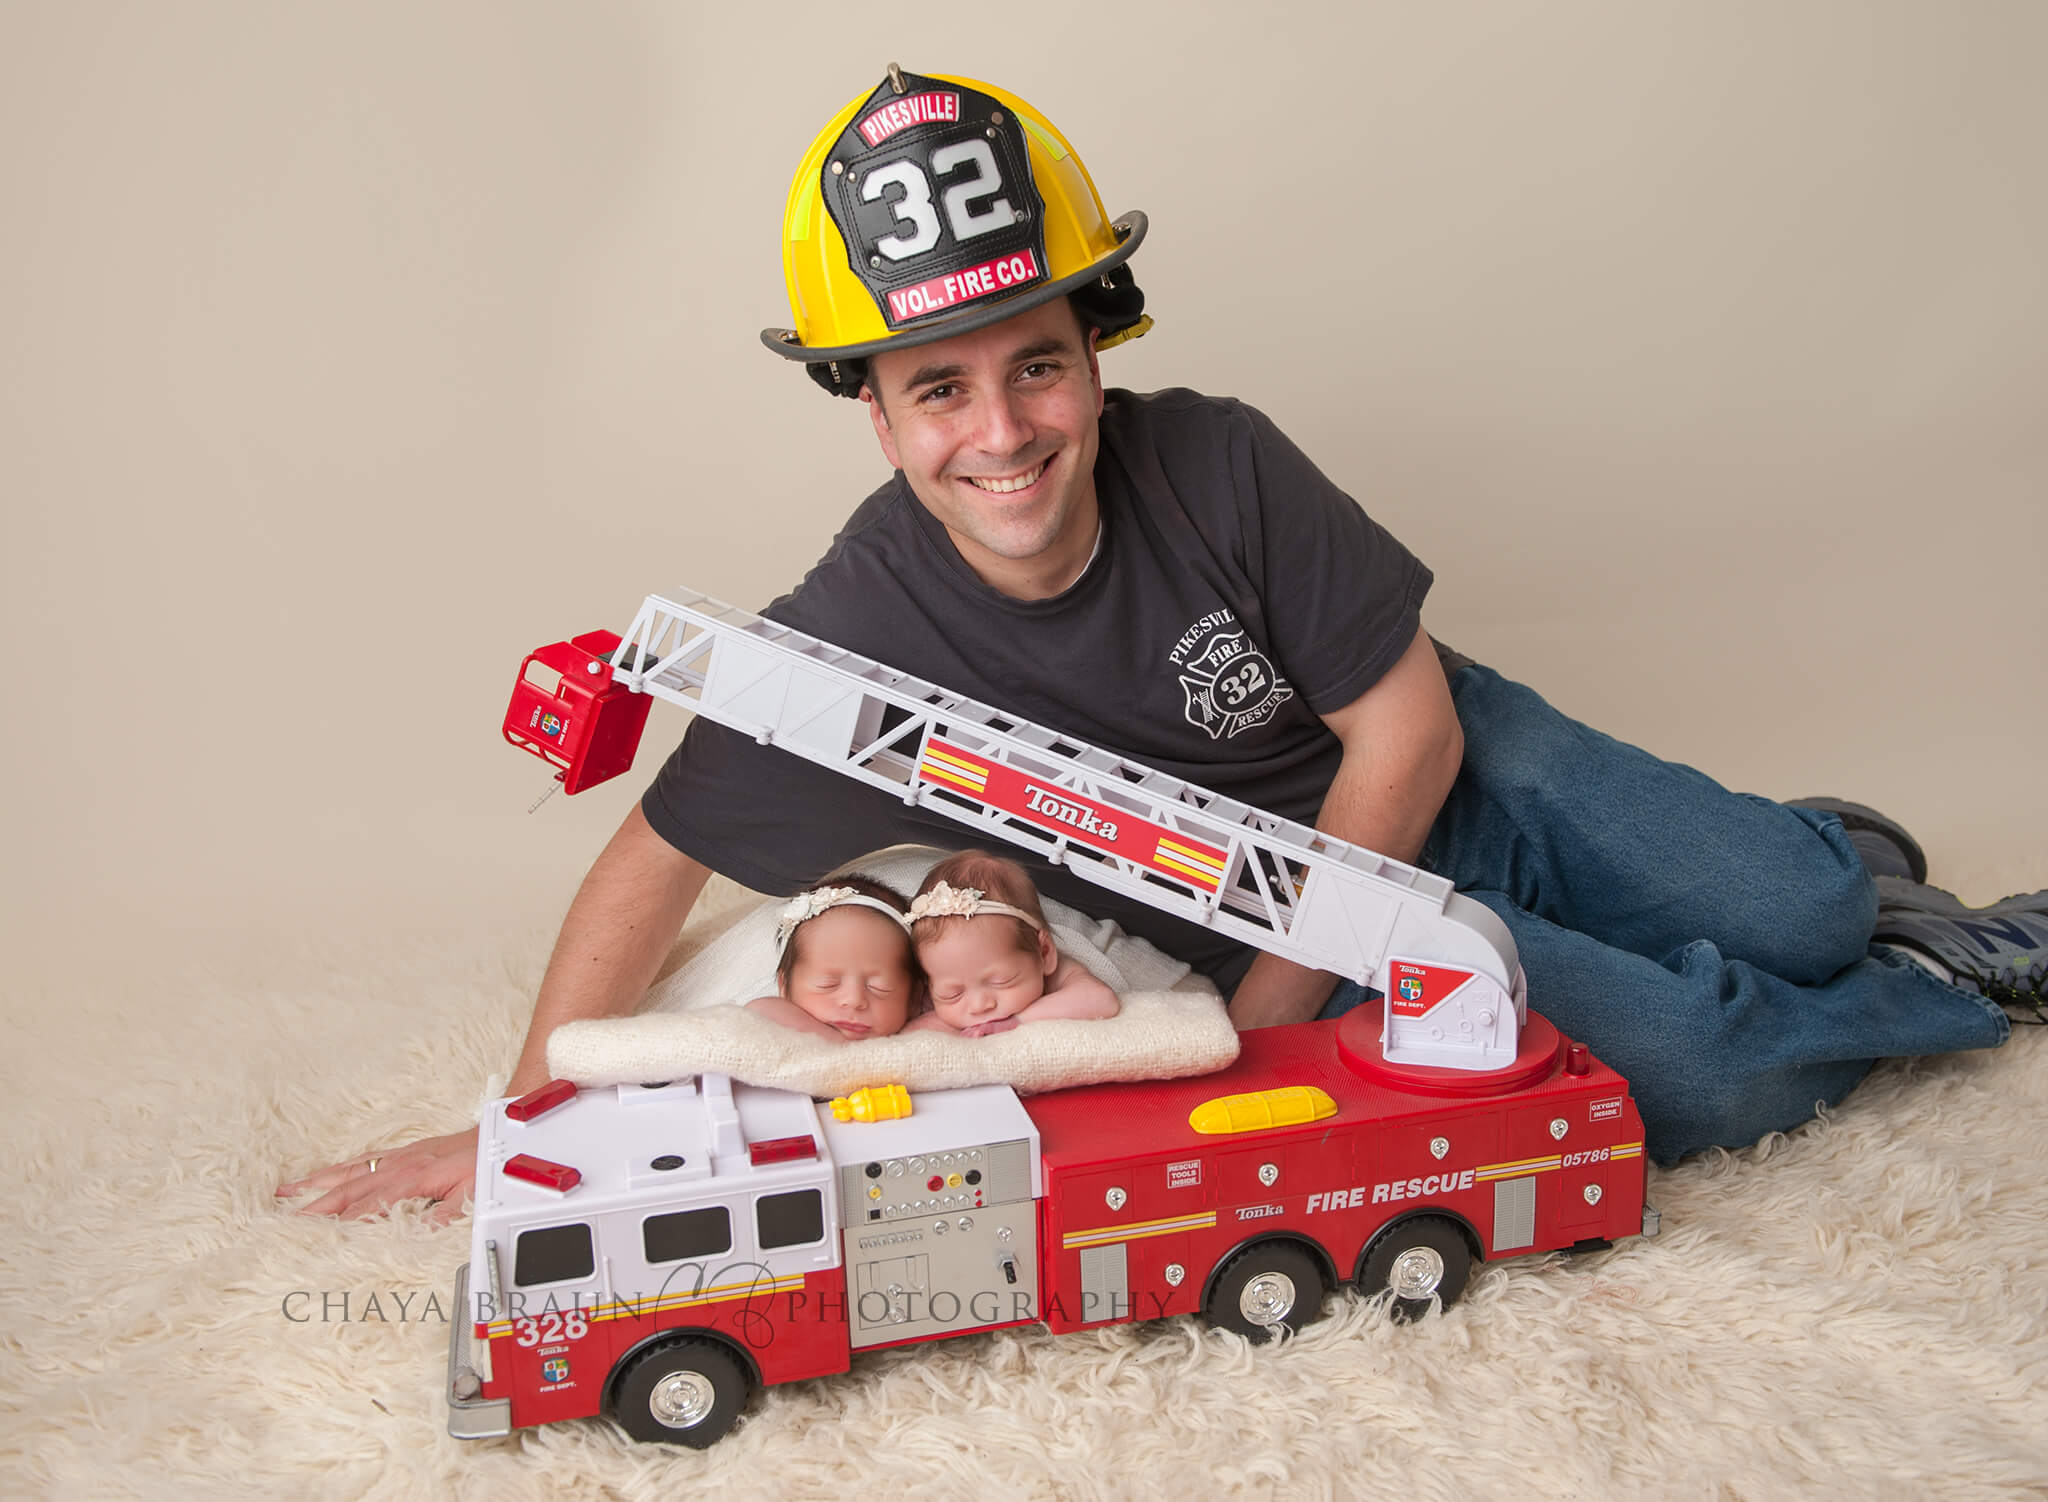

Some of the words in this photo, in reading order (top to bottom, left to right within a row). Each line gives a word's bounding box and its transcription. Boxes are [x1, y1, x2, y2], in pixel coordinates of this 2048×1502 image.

[864, 95, 954, 144] PIKESVILLE
[860, 138, 1016, 262] 32
[892, 287, 944, 318] VOL.
[944, 266, 995, 303] FIRE
[996, 258, 1034, 286] CO.
[1207, 638, 1243, 668] FIRE
[1220, 662, 1266, 705] 32
[1237, 691, 1284, 727] RESCUE
[1024, 783, 1119, 842] Tonka
[1399, 965, 1426, 976] Tonka
[1591, 1101, 1620, 1112] OXYGEN
[1593, 1108, 1617, 1117] INSIDE
[1168, 1162, 1199, 1171] RESCUE
[1562, 1147, 1610, 1168] 05786
[1171, 1169, 1197, 1180] TOOLS
[1171, 1177, 1197, 1187] INSIDE
[1306, 1187, 1366, 1215] FIRE
[1371, 1169, 1476, 1204] RESCUE
[1235, 1204, 1285, 1221] Tonka
[515, 1310, 588, 1348] 328
